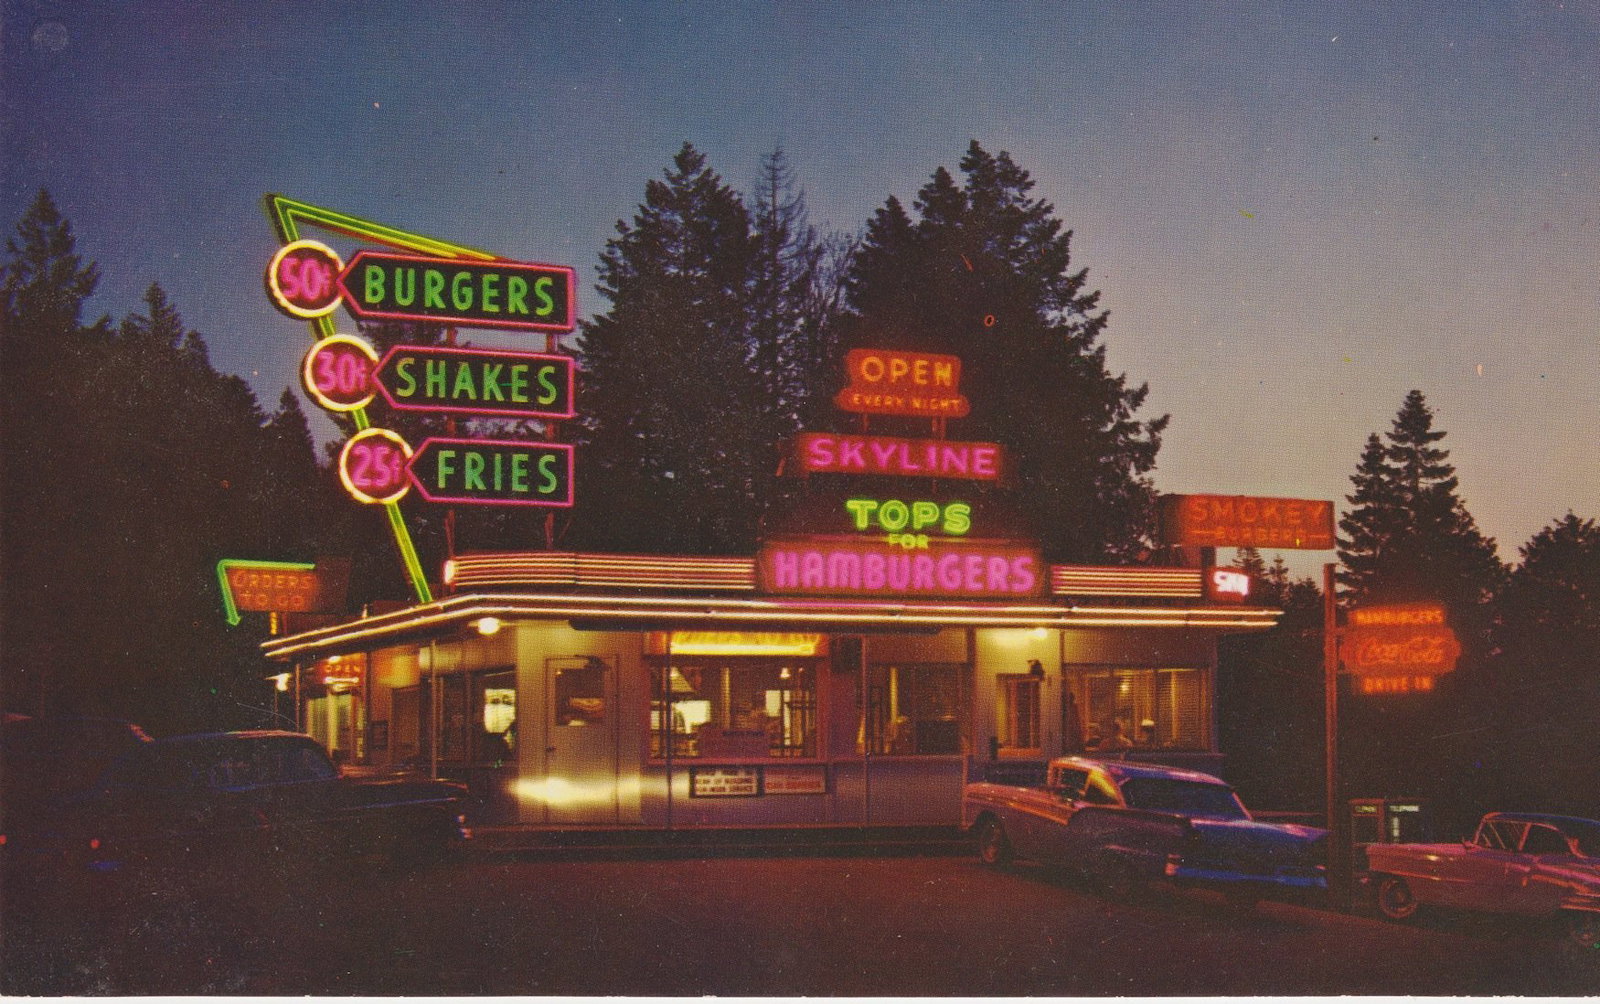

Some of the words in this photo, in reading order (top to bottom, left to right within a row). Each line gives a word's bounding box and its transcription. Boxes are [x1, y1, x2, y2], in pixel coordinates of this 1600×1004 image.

[364, 264, 554, 317] BURGERS
[395, 357, 558, 406] SHAKES
[860, 355, 953, 387] OPEN
[853, 393, 904, 407] EVERY
[911, 397, 961, 411] NIGHT
[807, 437, 997, 476] SKYLINE
[437, 450, 558, 494] FRIES
[845, 499, 972, 535] TOPS
[1186, 497, 1327, 526] SMOKEY
[887, 532, 930, 550] FOR
[232, 570, 313, 590] ORDERS
[772, 550, 1036, 593] HAMBURGERS
[239, 591, 269, 607] TO
[275, 594, 306, 608] GO
[324, 663, 362, 674] OPEN
[1362, 676, 1410, 693] DRIVE
[1414, 676, 1433, 691] IN
